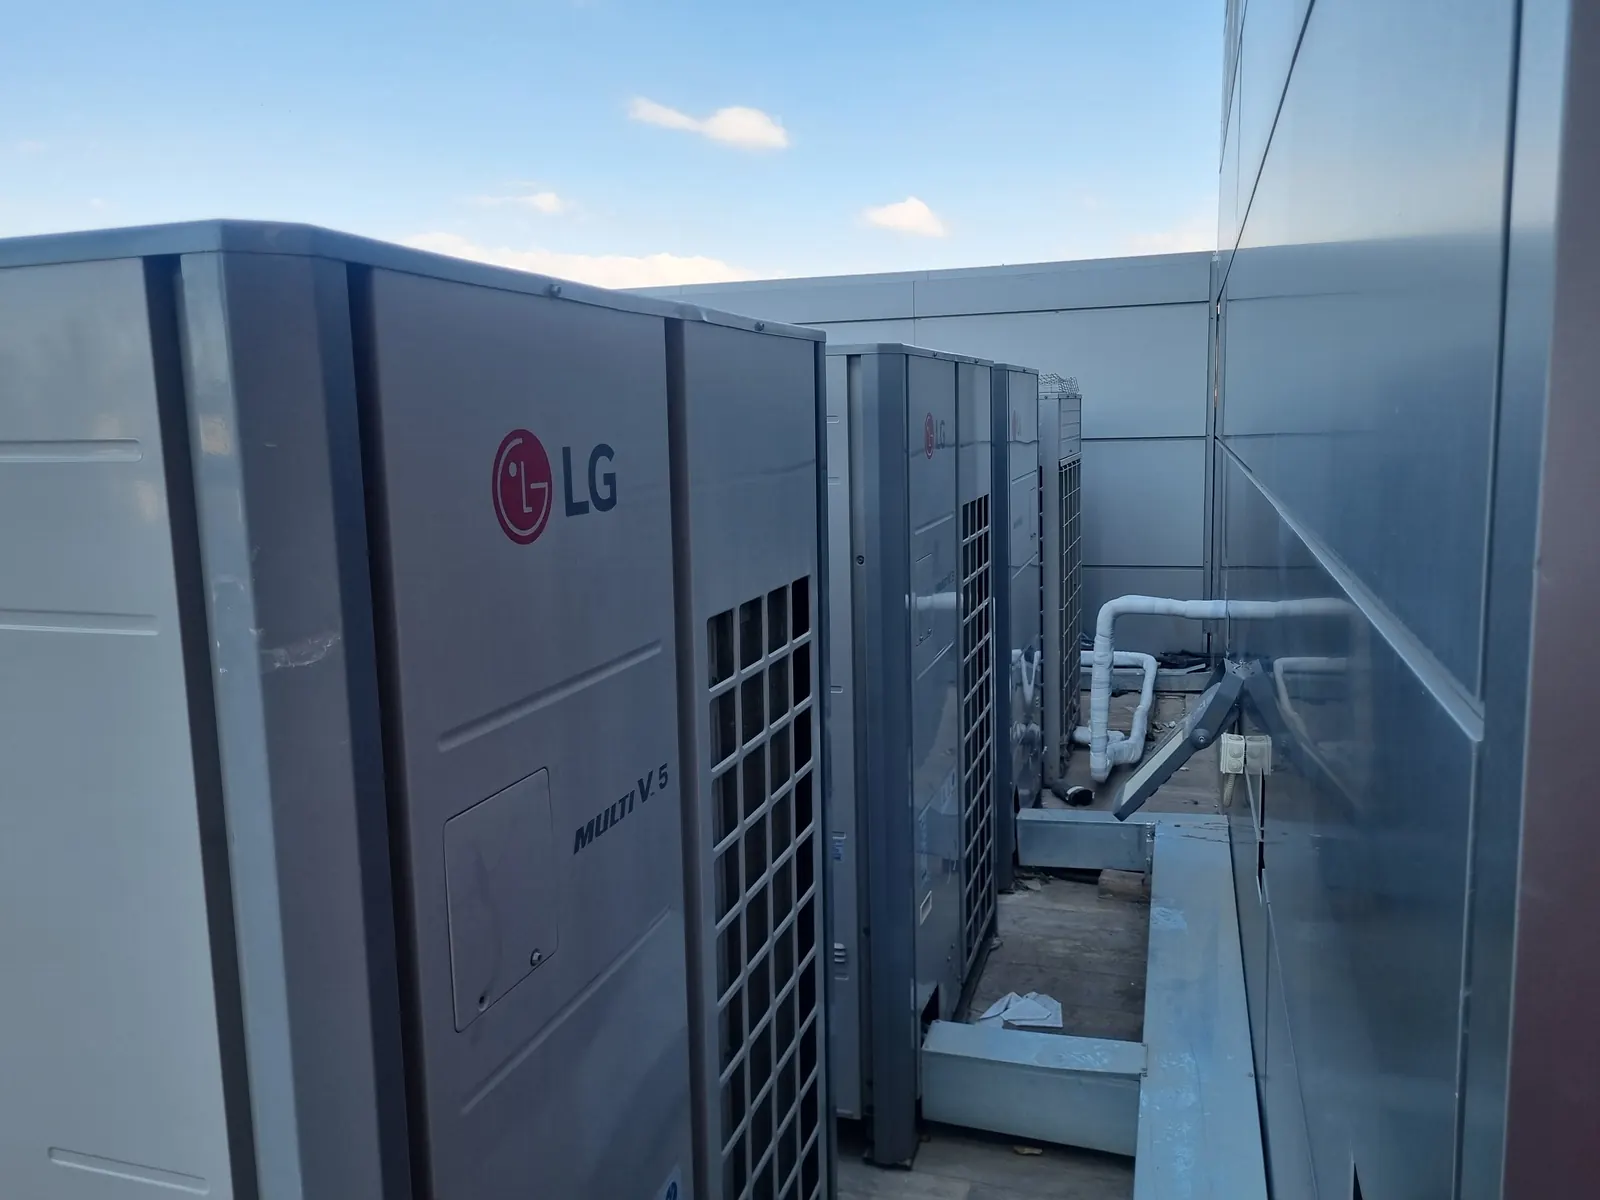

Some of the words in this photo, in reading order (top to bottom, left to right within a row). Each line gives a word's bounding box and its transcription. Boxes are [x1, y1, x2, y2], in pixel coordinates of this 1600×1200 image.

[935, 419, 946, 450] LG
[562, 443, 618, 517] LG
[573, 789, 636, 856] MULTI
[658, 762, 668, 790] 5
